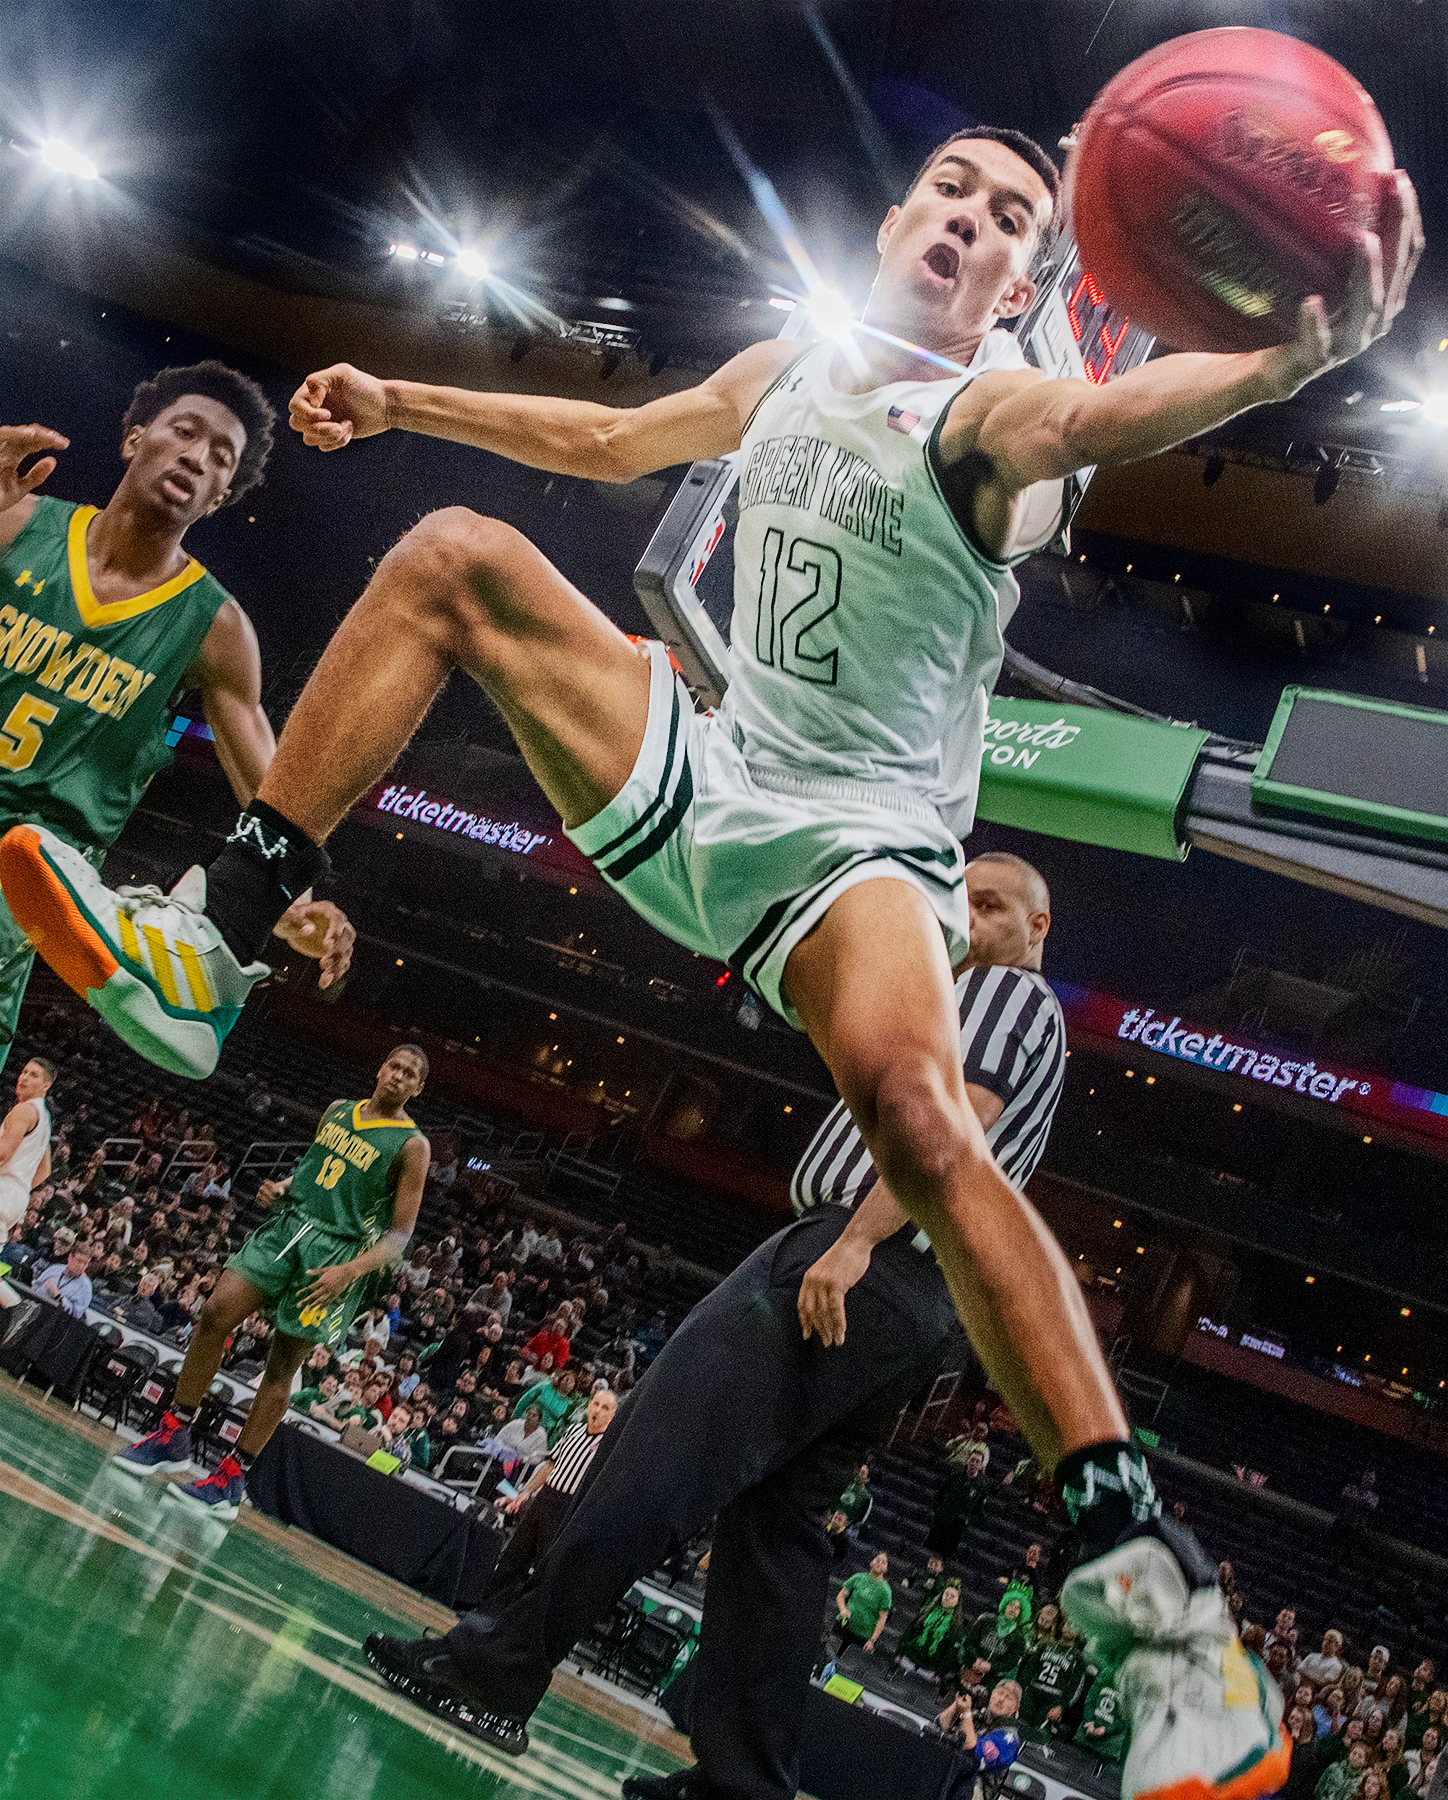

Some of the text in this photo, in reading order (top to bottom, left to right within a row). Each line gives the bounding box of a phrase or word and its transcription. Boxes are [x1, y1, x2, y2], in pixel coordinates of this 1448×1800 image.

[740, 435, 904, 557] GREEN WAVE
[756, 527, 842, 685] 12
[0, 603, 156, 720] SNOWDEN
[377, 785, 547, 854] ticketmaster
[315, 1122, 380, 1173] SNOWDEN
[315, 1154, 346, 1190] 13
[1039, 1661, 1060, 1686] 25
